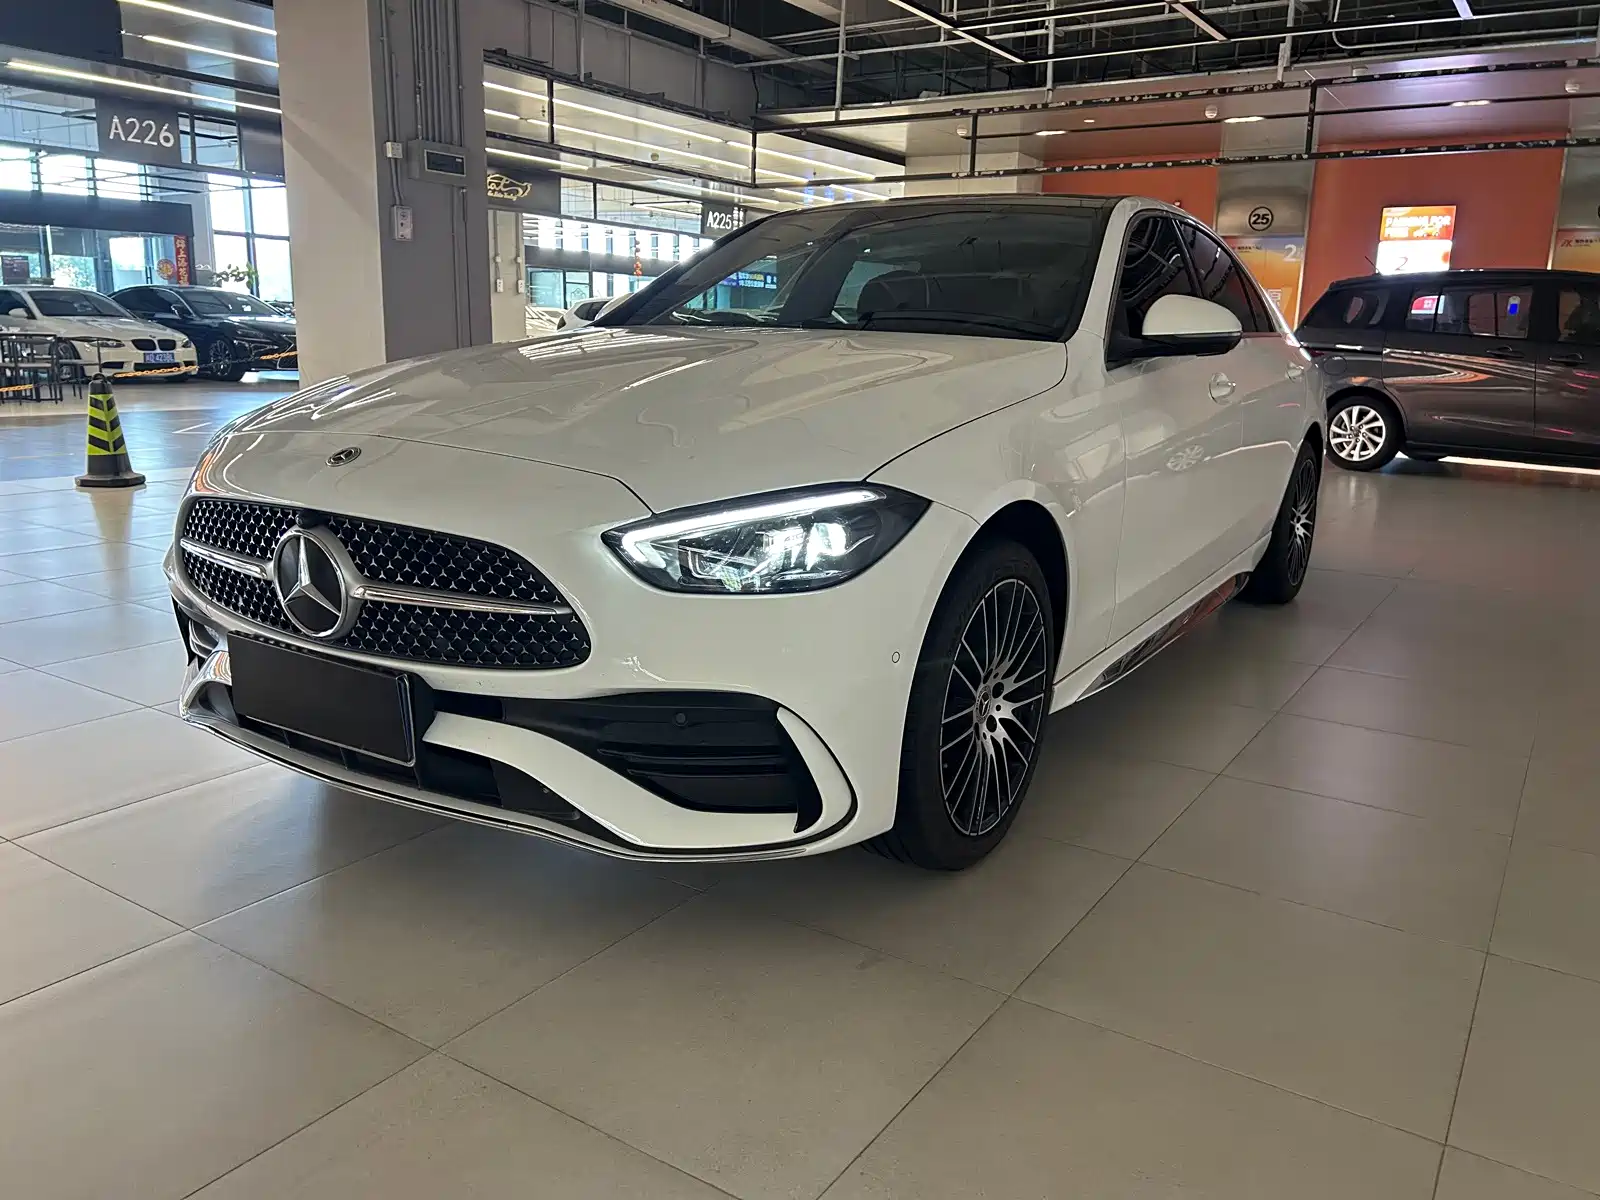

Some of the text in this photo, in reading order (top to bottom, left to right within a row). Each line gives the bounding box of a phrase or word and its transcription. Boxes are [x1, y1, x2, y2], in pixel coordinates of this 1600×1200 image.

[109, 114, 174, 148] A226
[706, 210, 732, 230] A225
[1251, 213, 1271, 225] 25
